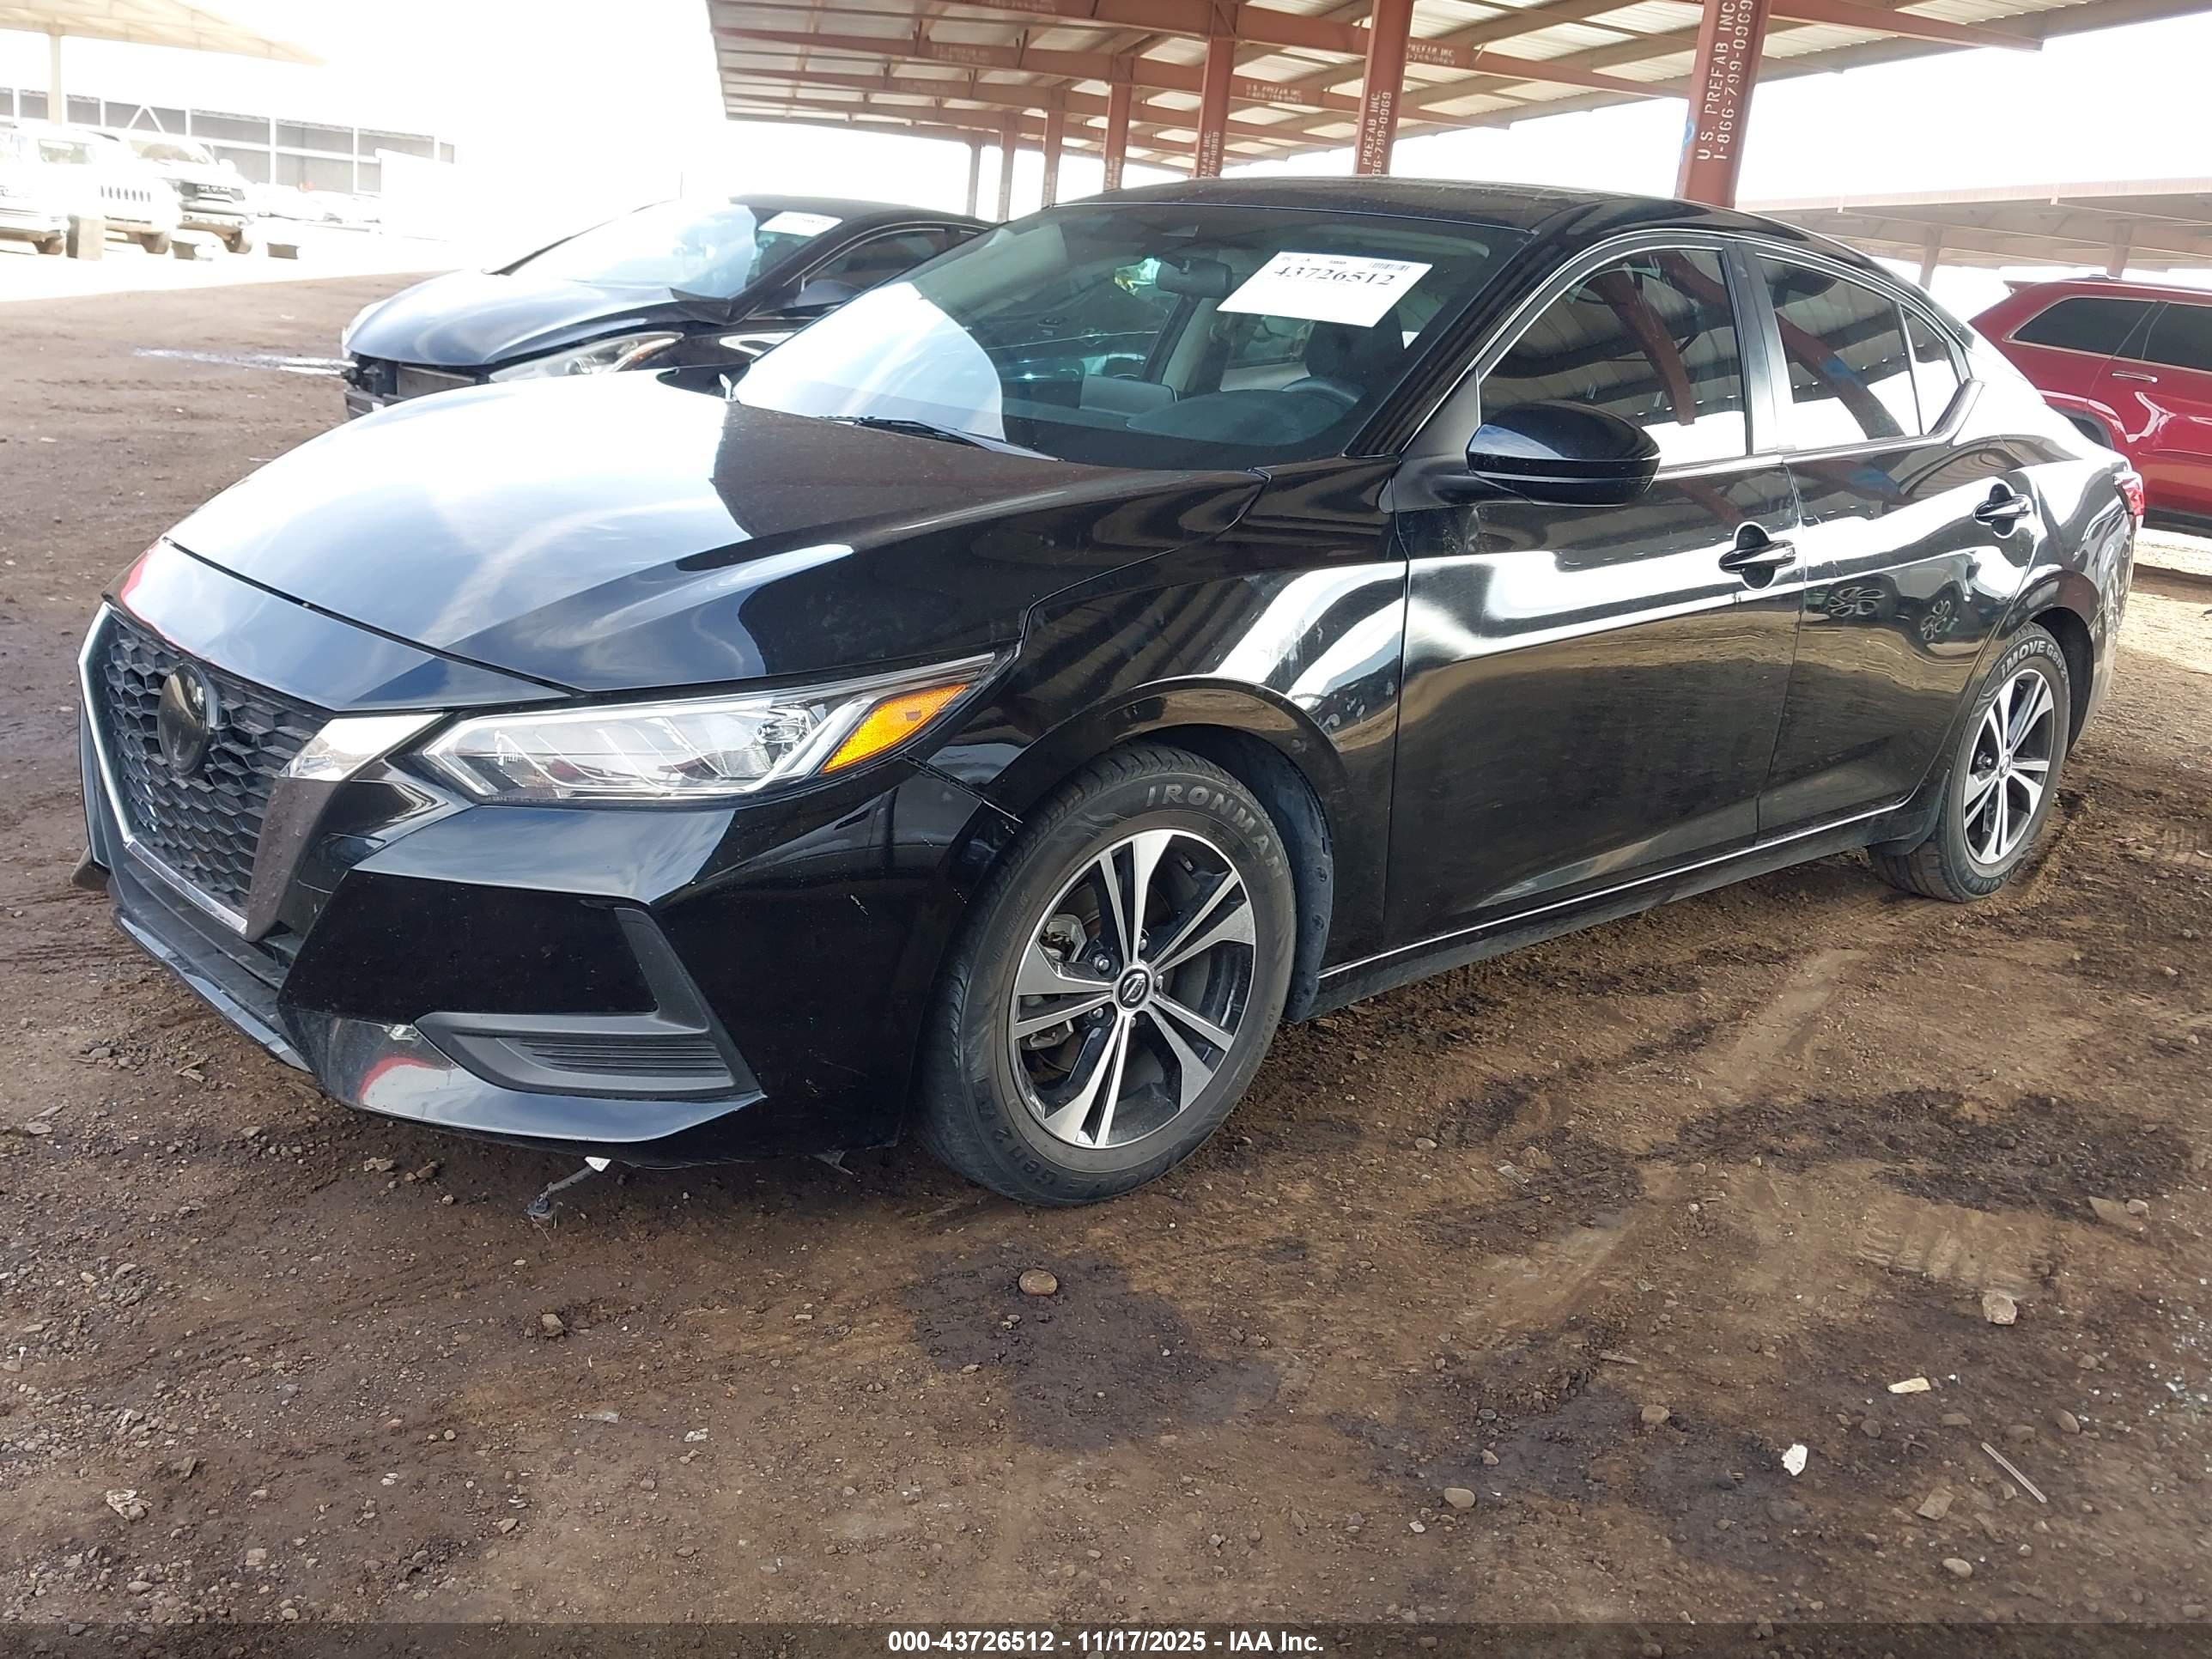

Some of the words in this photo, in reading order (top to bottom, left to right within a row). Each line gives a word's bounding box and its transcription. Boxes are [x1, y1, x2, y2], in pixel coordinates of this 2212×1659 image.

[1704, 42, 1729, 115] PREFAB
[1713, 0, 1754, 161] 1-866-799-0969
[1362, 118, 1377, 165] PREFAB
[1697, 125, 1716, 161] U.S.
[1274, 265, 1395, 286] 43726512
[1146, 783, 1285, 879] IRONMAN
